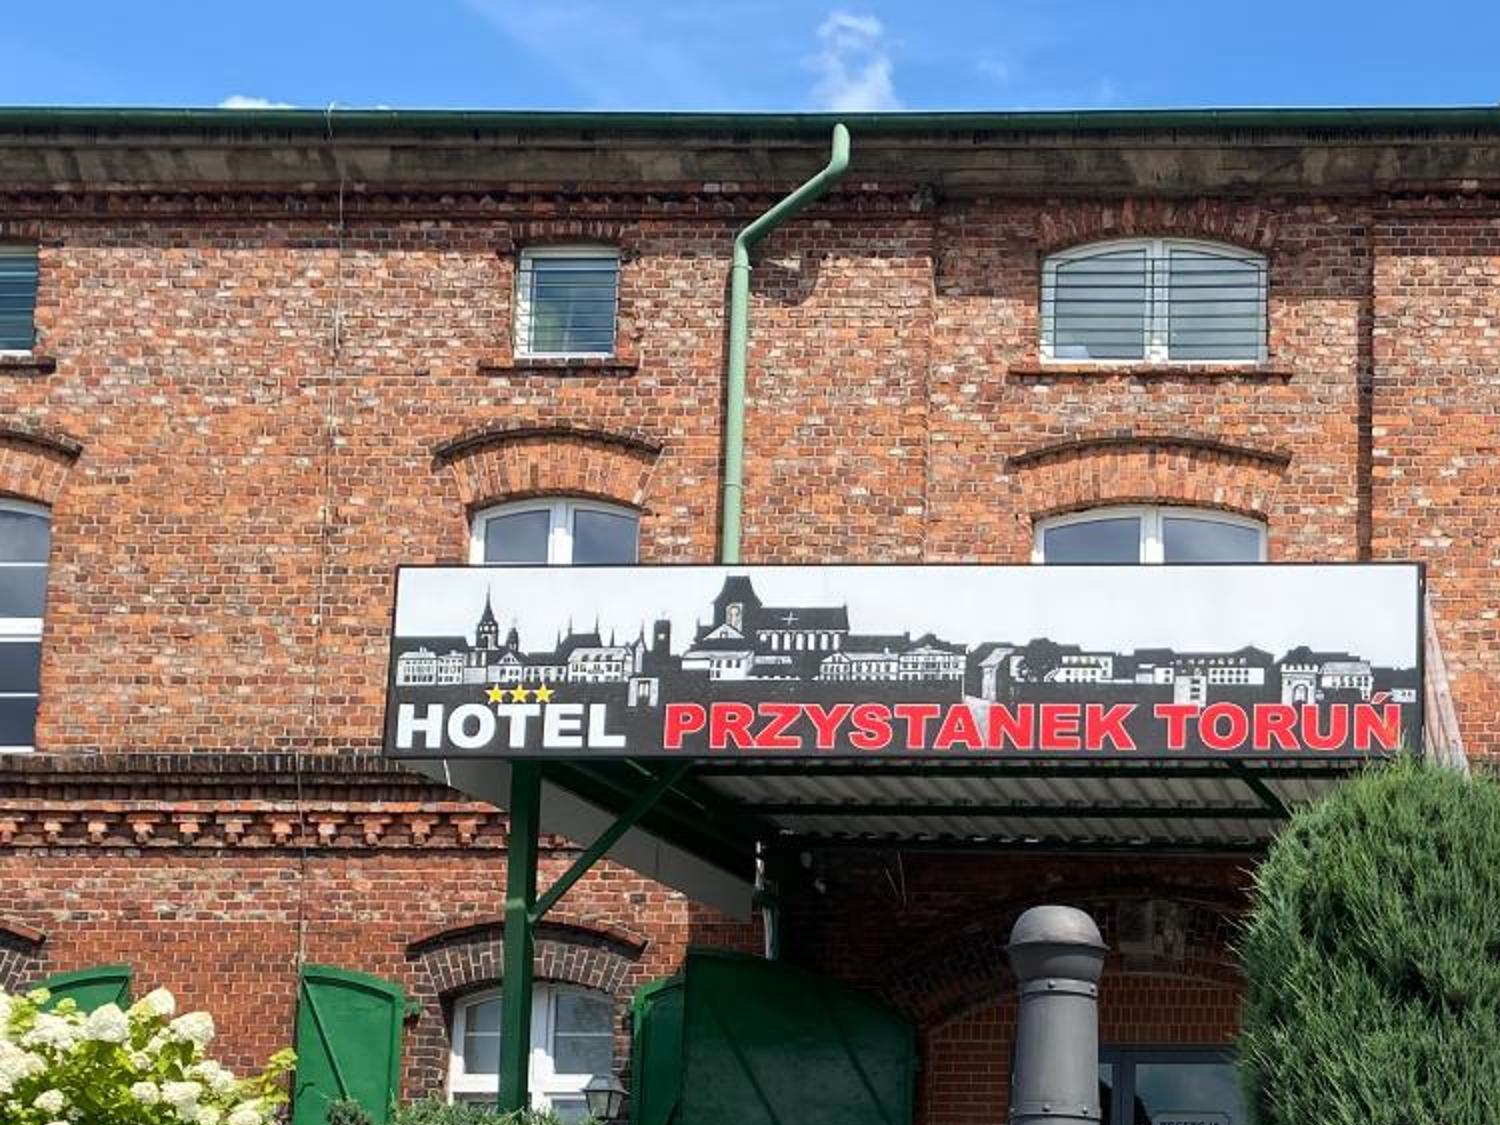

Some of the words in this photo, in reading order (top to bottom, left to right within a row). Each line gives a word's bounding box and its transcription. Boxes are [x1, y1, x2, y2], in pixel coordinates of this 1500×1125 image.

[396, 703, 626, 749] HOTEL
[663, 703, 1138, 751] PRZYSTANEK
[1153, 691, 1402, 751] TORUŃ
